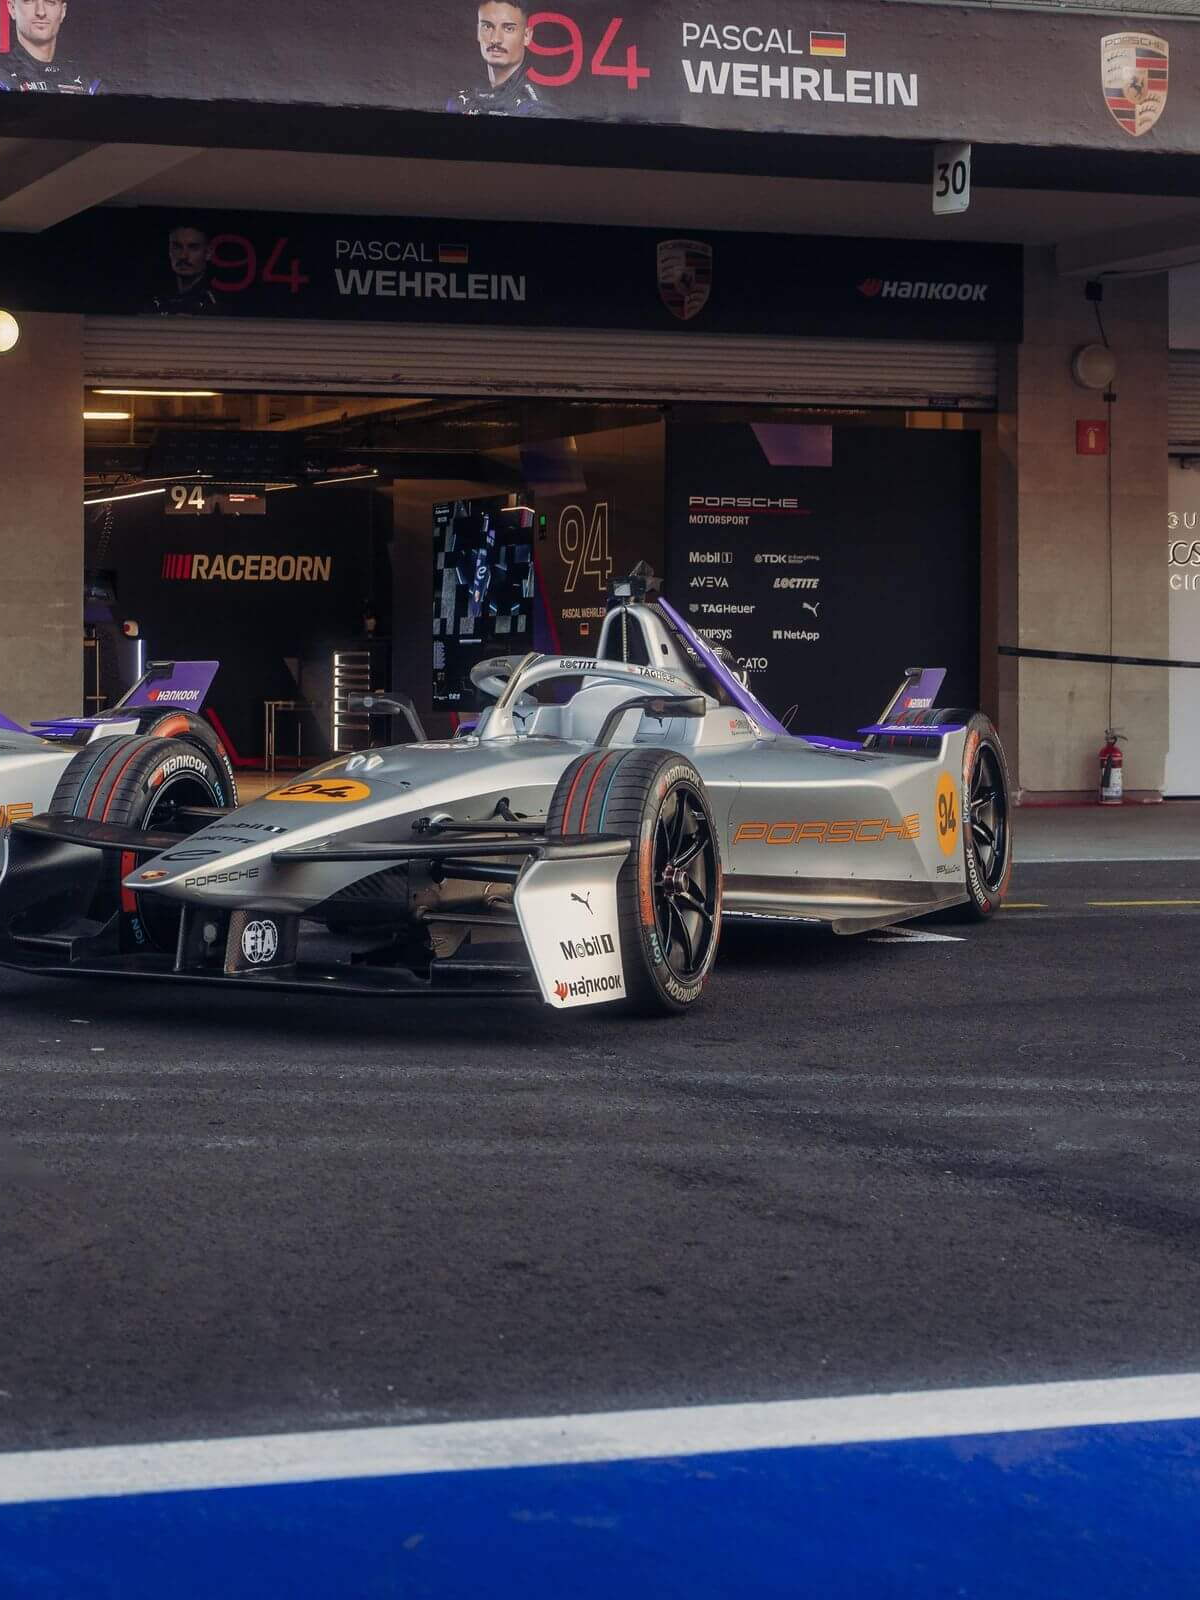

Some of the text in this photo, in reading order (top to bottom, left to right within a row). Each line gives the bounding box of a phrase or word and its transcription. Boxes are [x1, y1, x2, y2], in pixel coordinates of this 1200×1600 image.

[526, 11, 651, 90] 94
[682, 23, 803, 54] PASCAL
[682, 60, 918, 107] WEHRLEIN
[936, 160, 967, 197] 30
[335, 239, 433, 263] PASCAL
[208, 232, 312, 295] 94
[335, 267, 527, 301] WEHRLEIN
[171, 485, 205, 510] 94
[688, 496, 800, 508] PORSCHE
[688, 514, 750, 525] MOTORSPORT
[559, 503, 612, 592] 94
[688, 551, 720, 564] Mobil
[761, 554, 788, 564] TDK
[190, 554, 332, 582] RACEBORN
[689, 576, 730, 588] AVEVA
[773, 577, 820, 589] LOCTITE
[561, 607, 580, 619] PASCAL
[784, 630, 821, 641] NetApp
[559, 658, 598, 670] LOCTITE
[737, 657, 768, 670] CATO
[938, 792, 957, 836] 94
[733, 813, 920, 844] PORSCHE
[184, 868, 259, 888] PORSCHE
[560, 934, 615, 960] Mobil 1
